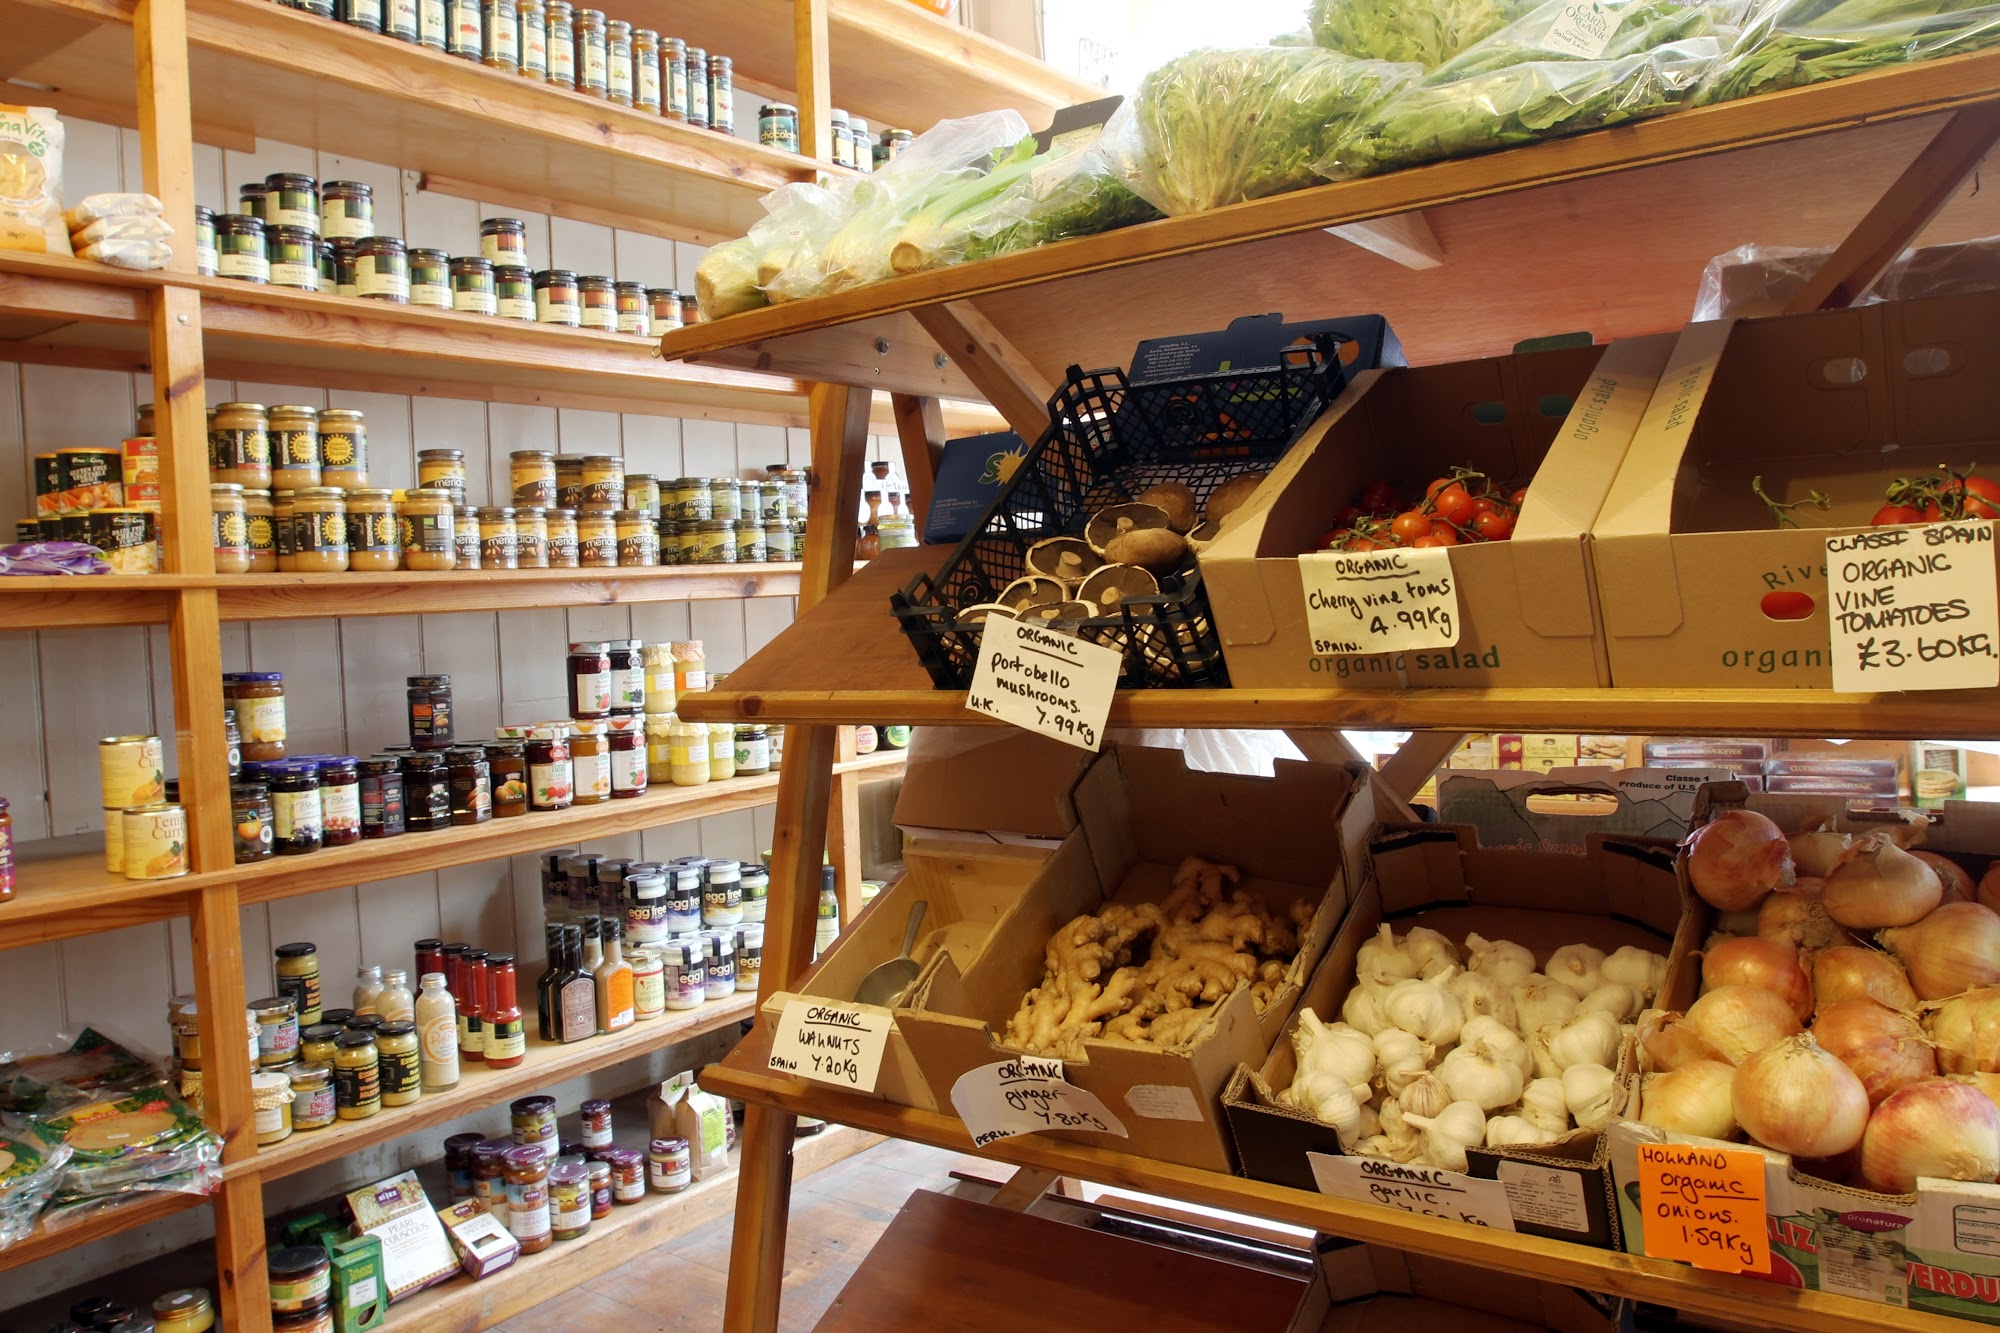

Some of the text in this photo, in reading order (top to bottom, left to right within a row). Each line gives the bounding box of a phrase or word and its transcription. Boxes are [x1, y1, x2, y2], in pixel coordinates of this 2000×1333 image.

[1565, 6, 1610, 42] ORGANIC
[1577, 4, 1611, 32] CAREY
[1552, 28, 1572, 43] Salad
[1565, 29, 1591, 46] Oriental
[1573, 377, 1618, 441] organic salad
[517, 535, 538, 544] dian
[1924, 524, 1993, 547] SPAIN
[1336, 553, 1409, 575] ORGANIC
[1842, 552, 1952, 584] ORGANIC
[1761, 564, 1828, 590] Rive
[1308, 577, 1451, 620] Cherry vine toms
[1835, 585, 1895, 612] VINE
[1369, 605, 1453, 639] 4.99Kg
[1835, 598, 1971, 635] TOMATOES
[1016, 626, 1079, 655] ORGANIC
[1314, 639, 1363, 653] SPAIN.
[991, 652, 1070, 690] Portobello
[1308, 645, 1500, 678] organic salad
[1721, 647, 1832, 674] organi
[996, 677, 1081, 714] mushrooms.
[1618, 780, 1700, 791] Produce of U.S.
[1665, 774, 1701, 783] Classe
[1849, 798, 1875, 806] FUDGE
[667, 899, 689, 912] egg
[705, 888, 742, 904] egg free
[628, 904, 667, 921] egg free
[709, 964, 731, 977] egg
[739, 957, 761, 968] egg
[680, 973, 700, 985] egg
[806, 1006, 862, 1027] ORGANIC
[273, 1040, 299, 1051] MUSTA
[798, 1028, 861, 1056] WALNUTS
[769, 1056, 798, 1071] SPAIN
[1005, 1088, 1068, 1111] ginger
[309, 1106, 336, 1118] MUSTA
[1641, 1147, 1728, 1170] HOLLAND
[1360, 1160, 1452, 1187] ORGANIC
[1846, 1213, 1905, 1229] pronatura
[1956, 1206, 1988, 1215] ORIGEN:
[384, 1223, 429, 1248] COUSCOUS
[388, 1218, 416, 1235] PEARL
[1766, 1215, 1819, 1254] LIZ
[1906, 1260, 2000, 1304] VERDU
